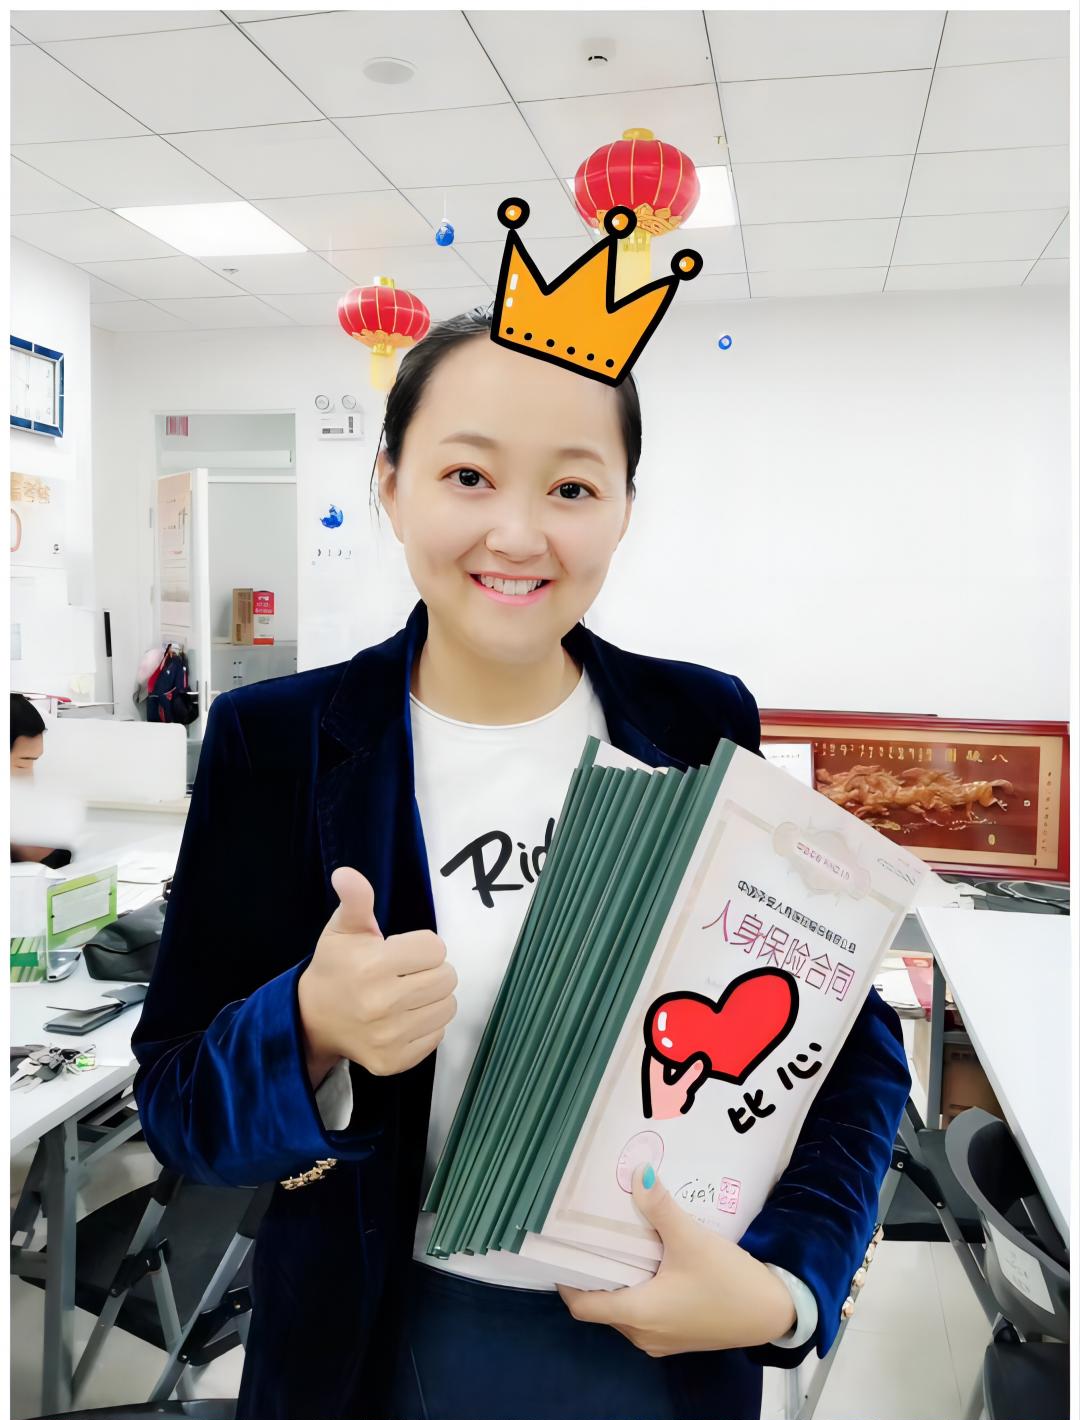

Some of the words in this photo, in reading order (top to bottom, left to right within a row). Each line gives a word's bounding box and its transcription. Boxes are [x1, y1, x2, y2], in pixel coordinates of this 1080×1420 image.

[702, 900, 855, 1001] 人身保险合同
